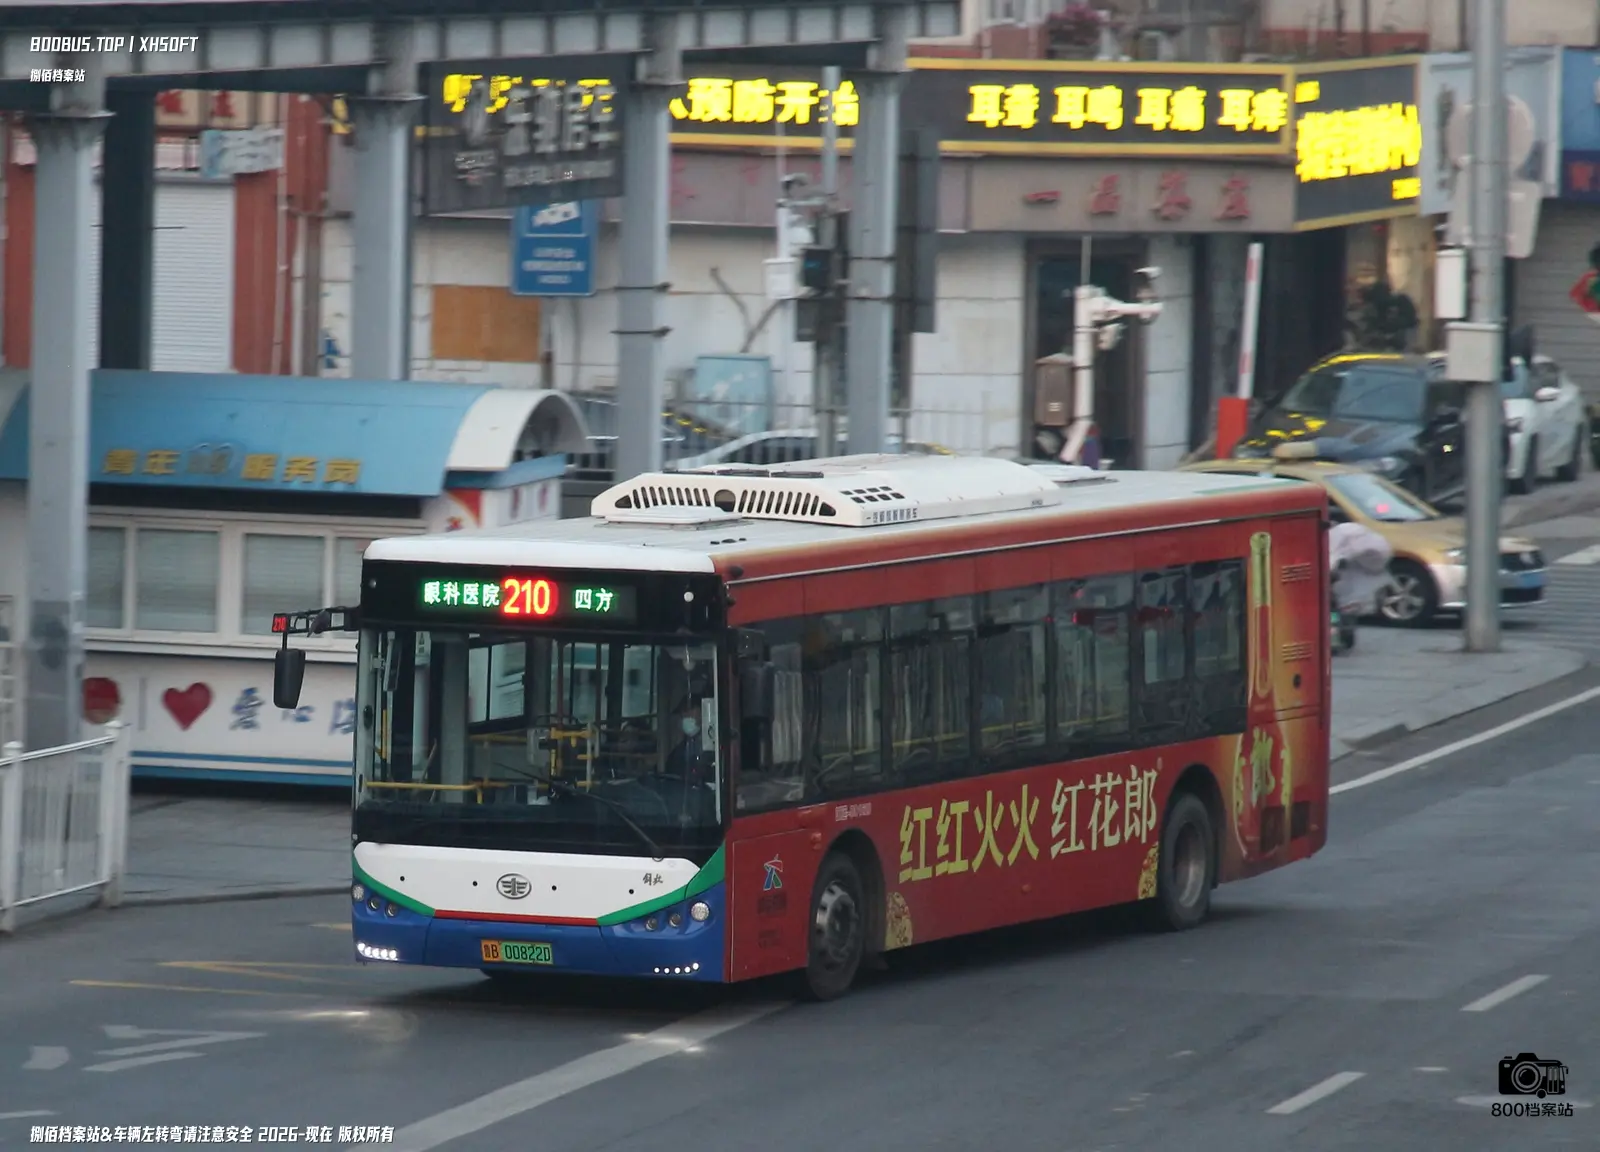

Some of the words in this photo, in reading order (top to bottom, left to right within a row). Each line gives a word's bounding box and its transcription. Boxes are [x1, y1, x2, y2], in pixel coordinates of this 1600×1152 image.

[668, 78, 860, 126] 预防开始
[424, 581, 500, 607] 眼科医院
[503, 578, 550, 615] 210
[575, 588, 614, 612] 四方
[899, 783, 1040, 884] 红红火火
[1050, 764, 1158, 861] 红花郎
